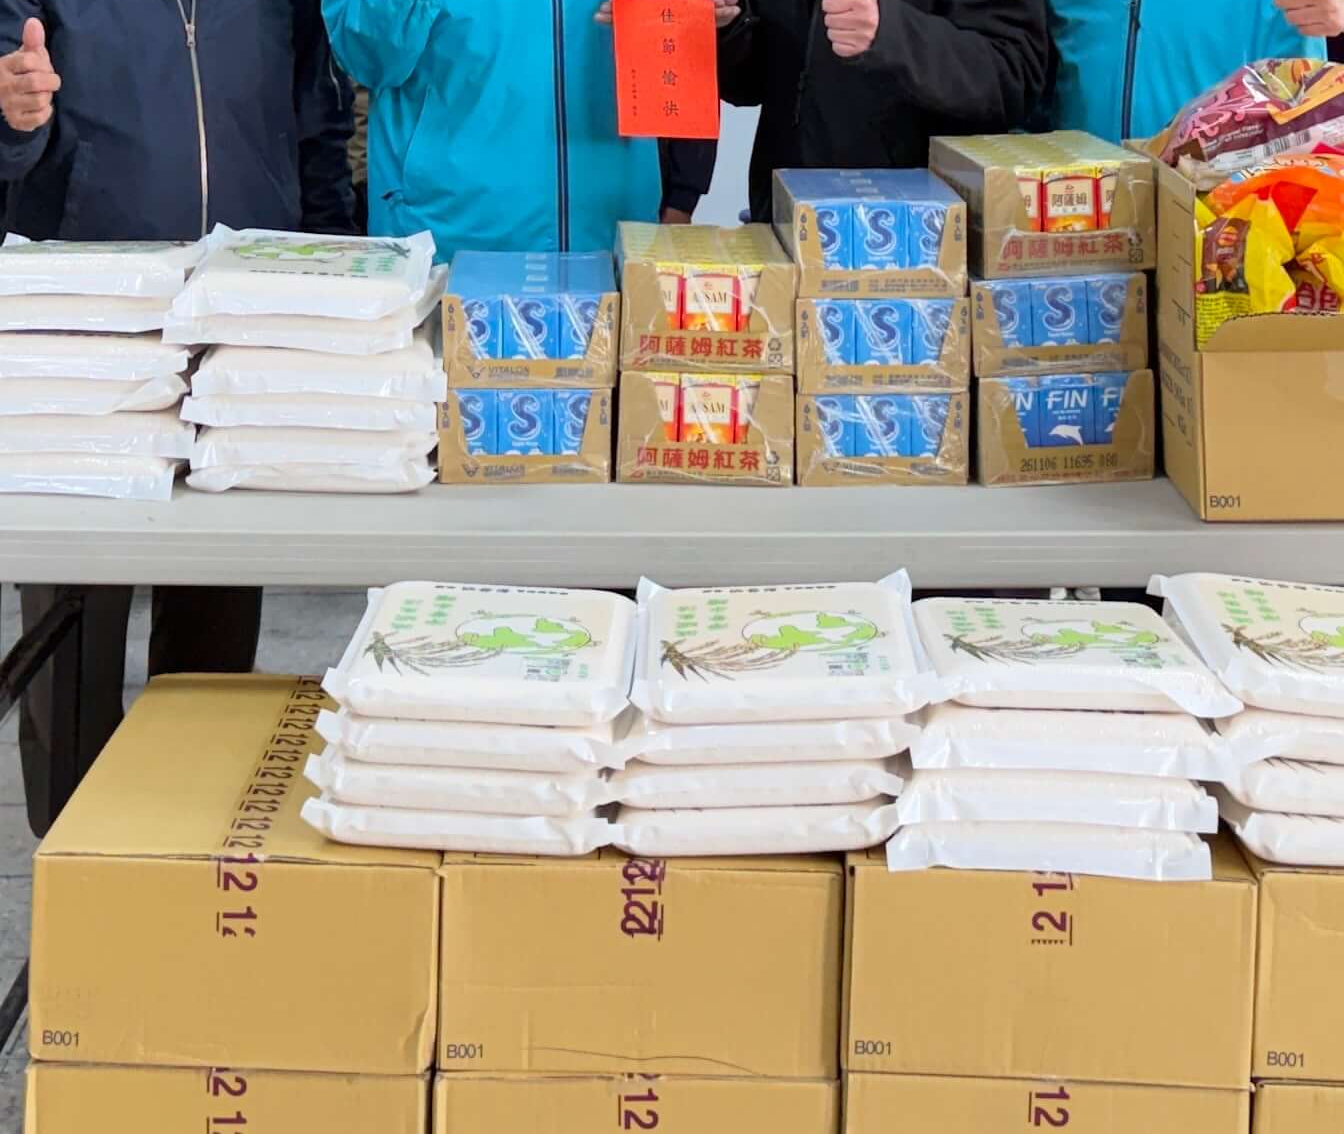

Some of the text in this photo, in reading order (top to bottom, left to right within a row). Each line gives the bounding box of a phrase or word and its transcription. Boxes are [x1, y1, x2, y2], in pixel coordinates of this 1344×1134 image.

[692, 290, 727, 304] ASAM
[639, 334, 764, 359] 阿薩姆紅茶
[690, 399, 725, 414] ASAM
[1046, 389, 1088, 410] FIN
[637, 447, 761, 472] 阿薩姆紅茶
[1209, 495, 1242, 509] B001
[276, 734, 309, 746] 12
[268, 750, 304, 762] 12
[260, 766, 296, 780] 12
[252, 783, 289, 797] 12
[244, 799, 281, 814] 12
[236, 816, 273, 832] 12
[228, 835, 266, 850] 12
[42, 1030, 80, 1047] B001
[446, 1043, 485, 1059] B001
[853, 1039, 893, 1056] B001
[1266, 1051, 1306, 1067] B001
[623, 1087, 659, 1130] 12
[1034, 1085, 1071, 1129] 12
